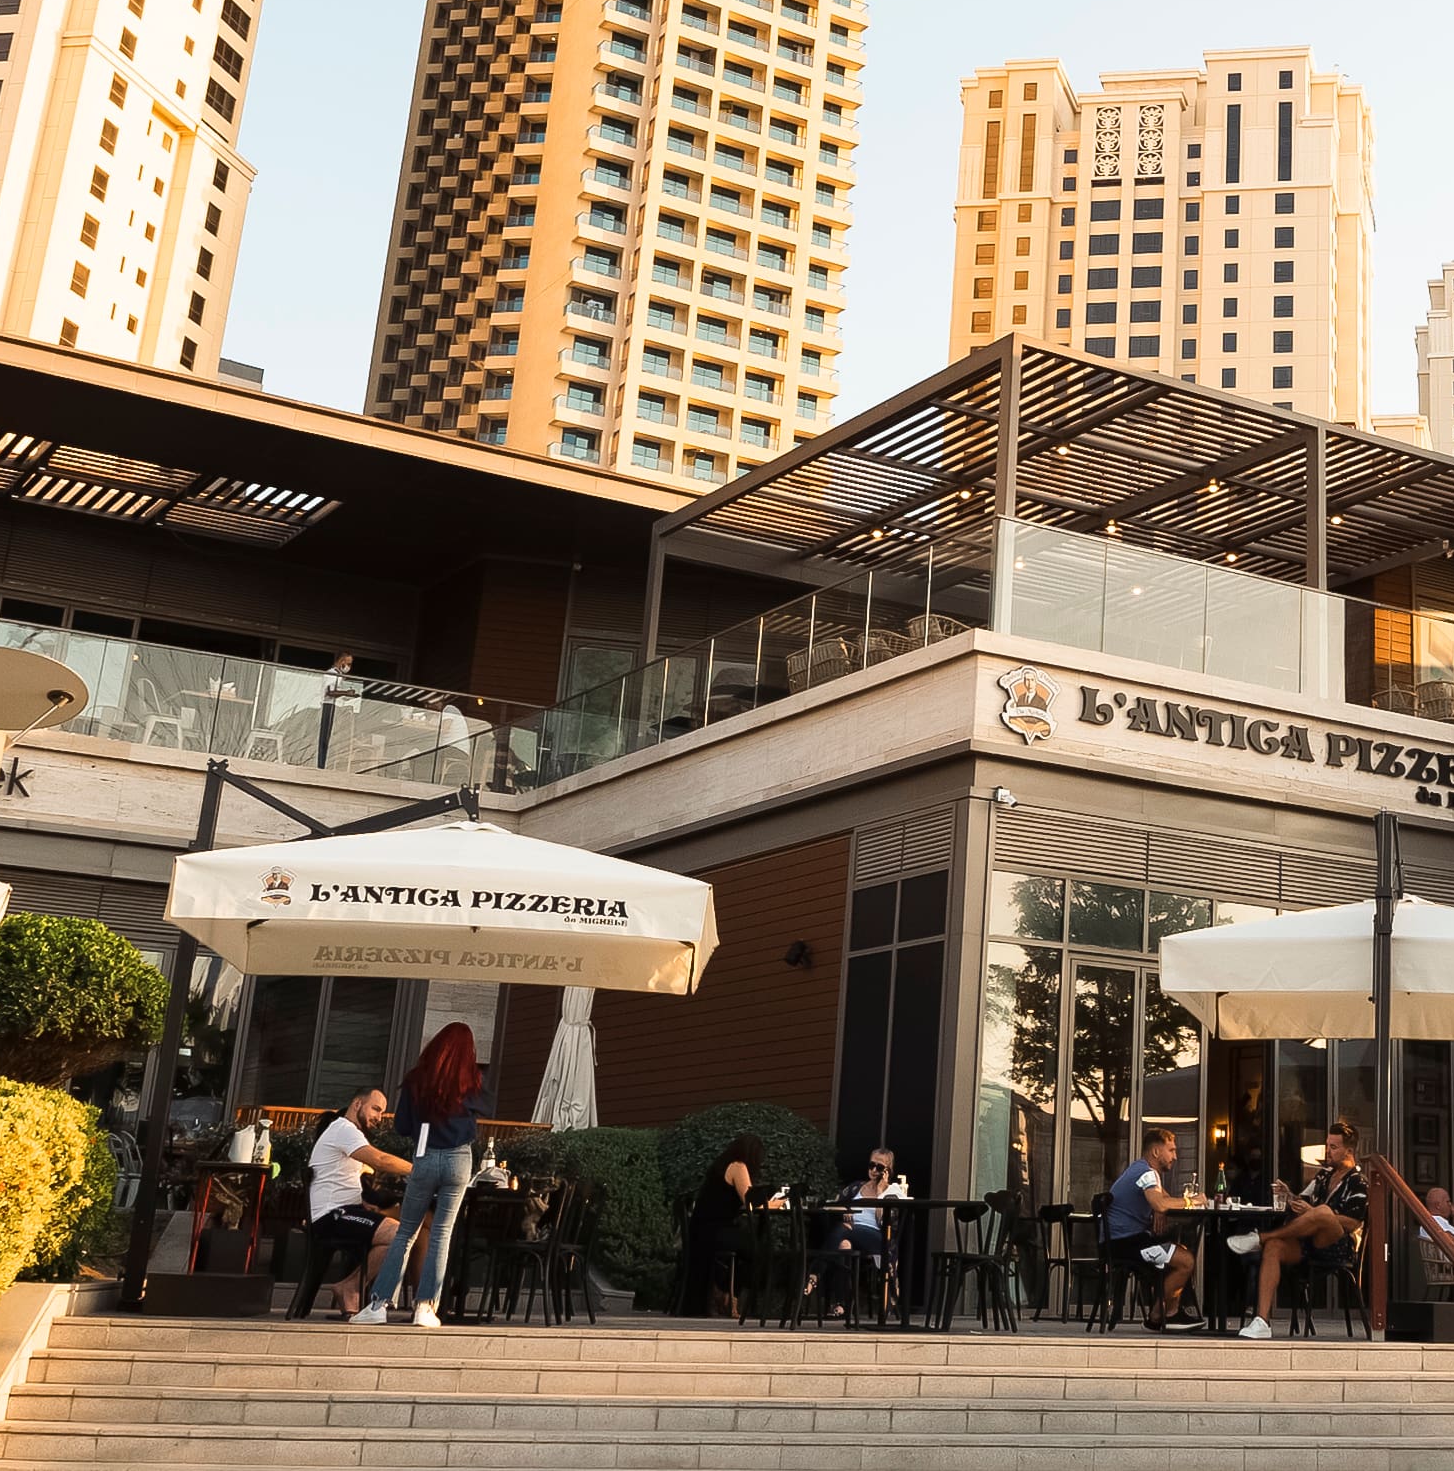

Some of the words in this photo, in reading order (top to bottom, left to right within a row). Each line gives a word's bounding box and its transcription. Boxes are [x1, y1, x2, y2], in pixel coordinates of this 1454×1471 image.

[1078, 686, 1314, 764] L'ANTICA
[1415, 785, 1442, 807] da
[309, 883, 462, 908] L'ANTICA
[470, 890, 629, 919] PIZZERIA
